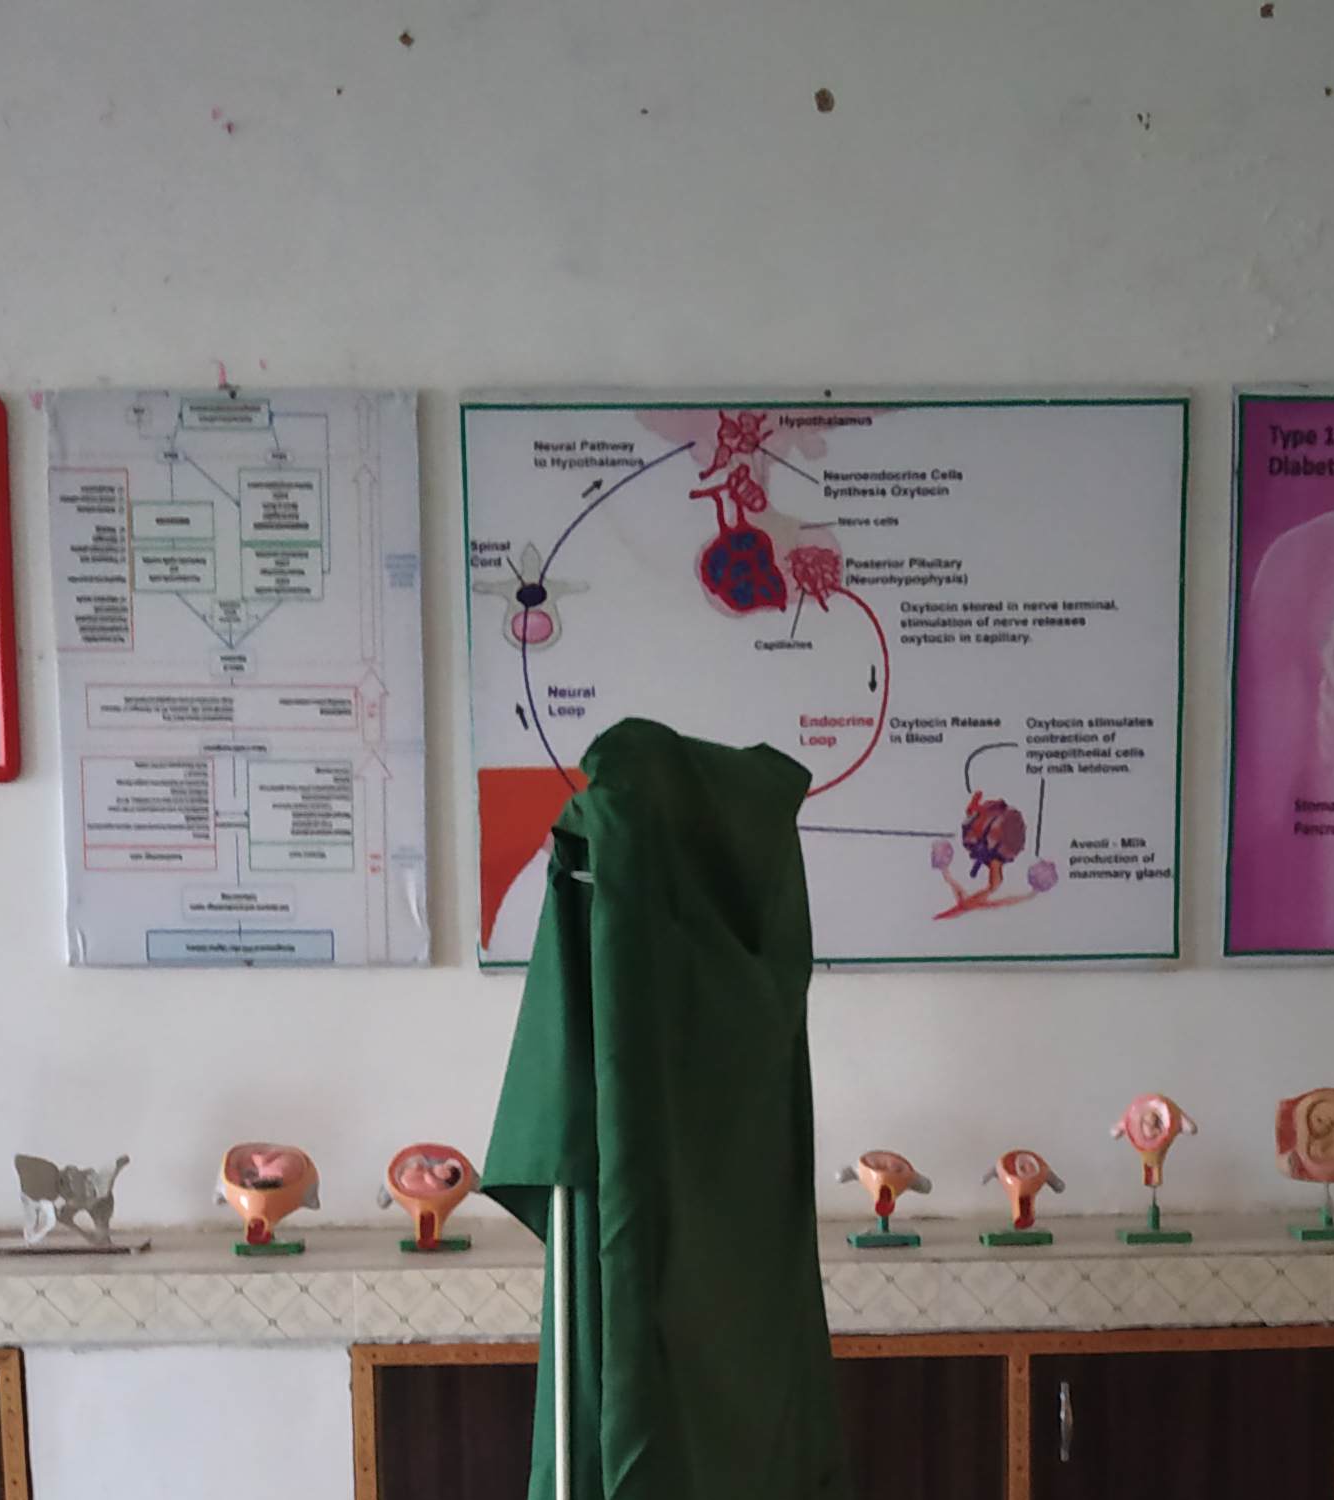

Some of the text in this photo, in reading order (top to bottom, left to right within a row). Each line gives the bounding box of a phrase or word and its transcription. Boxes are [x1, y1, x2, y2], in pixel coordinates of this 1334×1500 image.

[779, 415, 872, 427] Hypothalamus
[1269, 425, 1334, 450] Type 1
[533, 439, 635, 455] Neural Pathway
[533, 456, 644, 471] to Hypothalamus
[823, 468, 963, 482] Neuroendocrine Cells
[824, 485, 950, 501] Synthesis Oxytocin
[838, 515, 899, 526] Nerve cells
[470, 541, 511, 554] Spinal
[470, 556, 502, 568] Cord
[845, 557, 905, 569] Posterior
[845, 574, 968, 589] (Neurohypophysis)
[900, 601, 958, 615] Oxytocin
[963, 601, 1003, 612] stored
[1007, 601, 1019, 612] in
[1023, 602, 1058, 611] nerve
[900, 616, 1086, 628] stimulation of nerve releases
[900, 632, 955, 646] oxytocin
[959, 632, 971, 643] in
[547, 685, 596, 698] Neural
[548, 704, 586, 719] Loop
[799, 715, 875, 727] Endocrine
[889, 718, 1001, 731] Oxytocin Release
[1026, 718, 1154, 731] Oxytocin stimulates
[800, 735, 837, 748] Loop
[890, 733, 944, 744] in Blood
[1026, 733, 1116, 744] contraction of
[1026, 748, 1145, 761] myoepithelial cells
[1026, 764, 1044, 774] for
[1047, 764, 1074, 774] milk
[1120, 838, 1146, 848] Milk
[1069, 853, 1155, 866] production of
[1069, 869, 1131, 880] mammary
